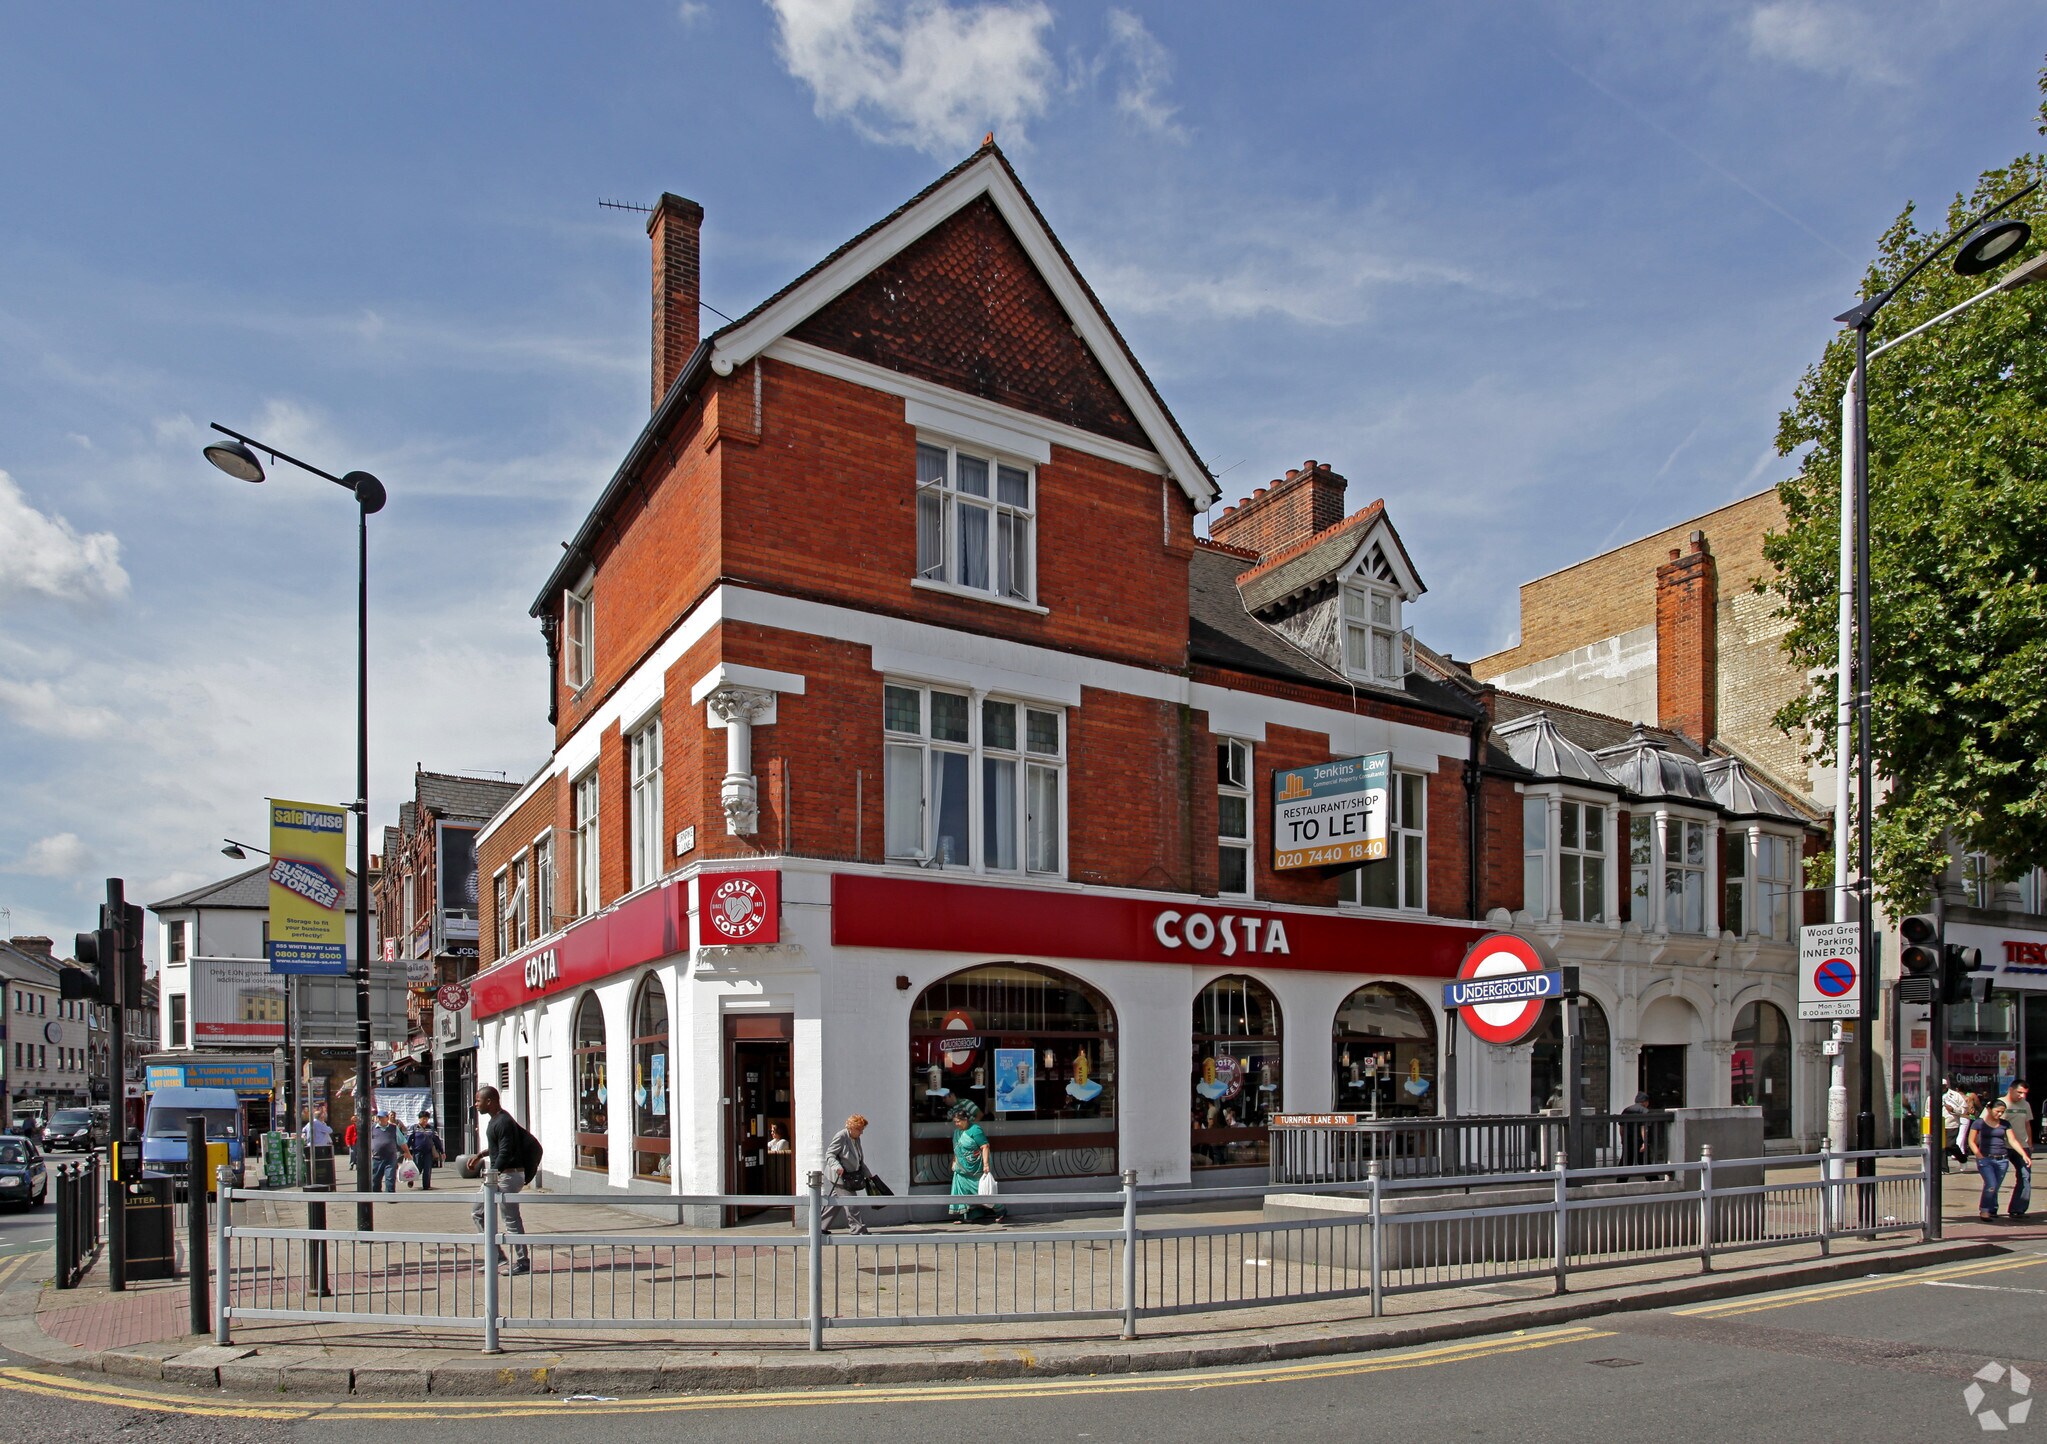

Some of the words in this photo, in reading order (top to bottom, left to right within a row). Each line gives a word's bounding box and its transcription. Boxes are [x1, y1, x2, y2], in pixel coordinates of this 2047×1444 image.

[1313, 764, 1354, 780] Jenkins
[1362, 759, 1385, 771] Law
[1313, 778, 1338, 787] Commercial
[1338, 776, 1358, 784] Property
[1359, 771, 1385, 780] Consultants
[1283, 795, 1379, 819] RESTAURANT/SHOP
[275, 810, 343, 829] safehouse
[1288, 819, 1319, 842] TO
[1329, 810, 1373, 837] LET
[1277, 853, 1302, 868] 020
[1308, 847, 1342, 863] 7440
[1349, 841, 1383, 858] 1840
[275, 860, 339, 898] BUSINESS
[295, 864, 327, 883] SAFEHOUSE
[270, 870, 335, 908] STORAGE
[717, 881, 757, 900] COSTA
[286, 918, 312, 926] Storage
[715, 913, 762, 935] COFFEE
[1154, 910, 1290, 957] COSTA
[1807, 927, 1834, 937] Wood
[1836, 926, 1861, 935] Gree
[1817, 937, 1854, 946] Parking
[319, 952, 342, 960] 5000
[457, 947, 479, 956] JCDe
[1802, 947, 1836, 958] INNER
[1839, 946, 1861, 956] ZON
[2001, 941, 2047, 965] TESC
[210, 969, 226, 978] Only
[525, 949, 557, 989] COSTA
[443, 985, 463, 994] COSTA
[1453, 975, 1551, 1004] UNDERGROUND
[442, 999, 465, 1009] COFFEE
[200, 1067, 237, 1075] TURNPIKE
[238, 1067, 258, 1075] LANE
[187, 1078, 204, 1087] FOOD
[205, 1077, 225, 1086] STORE
[244, 1077, 269, 1085] LICENCE
[1280, 1115, 1312, 1124] TURNPIKE
[1314, 1115, 1332, 1124] LANE
[125, 1196, 156, 1205] LITTER
